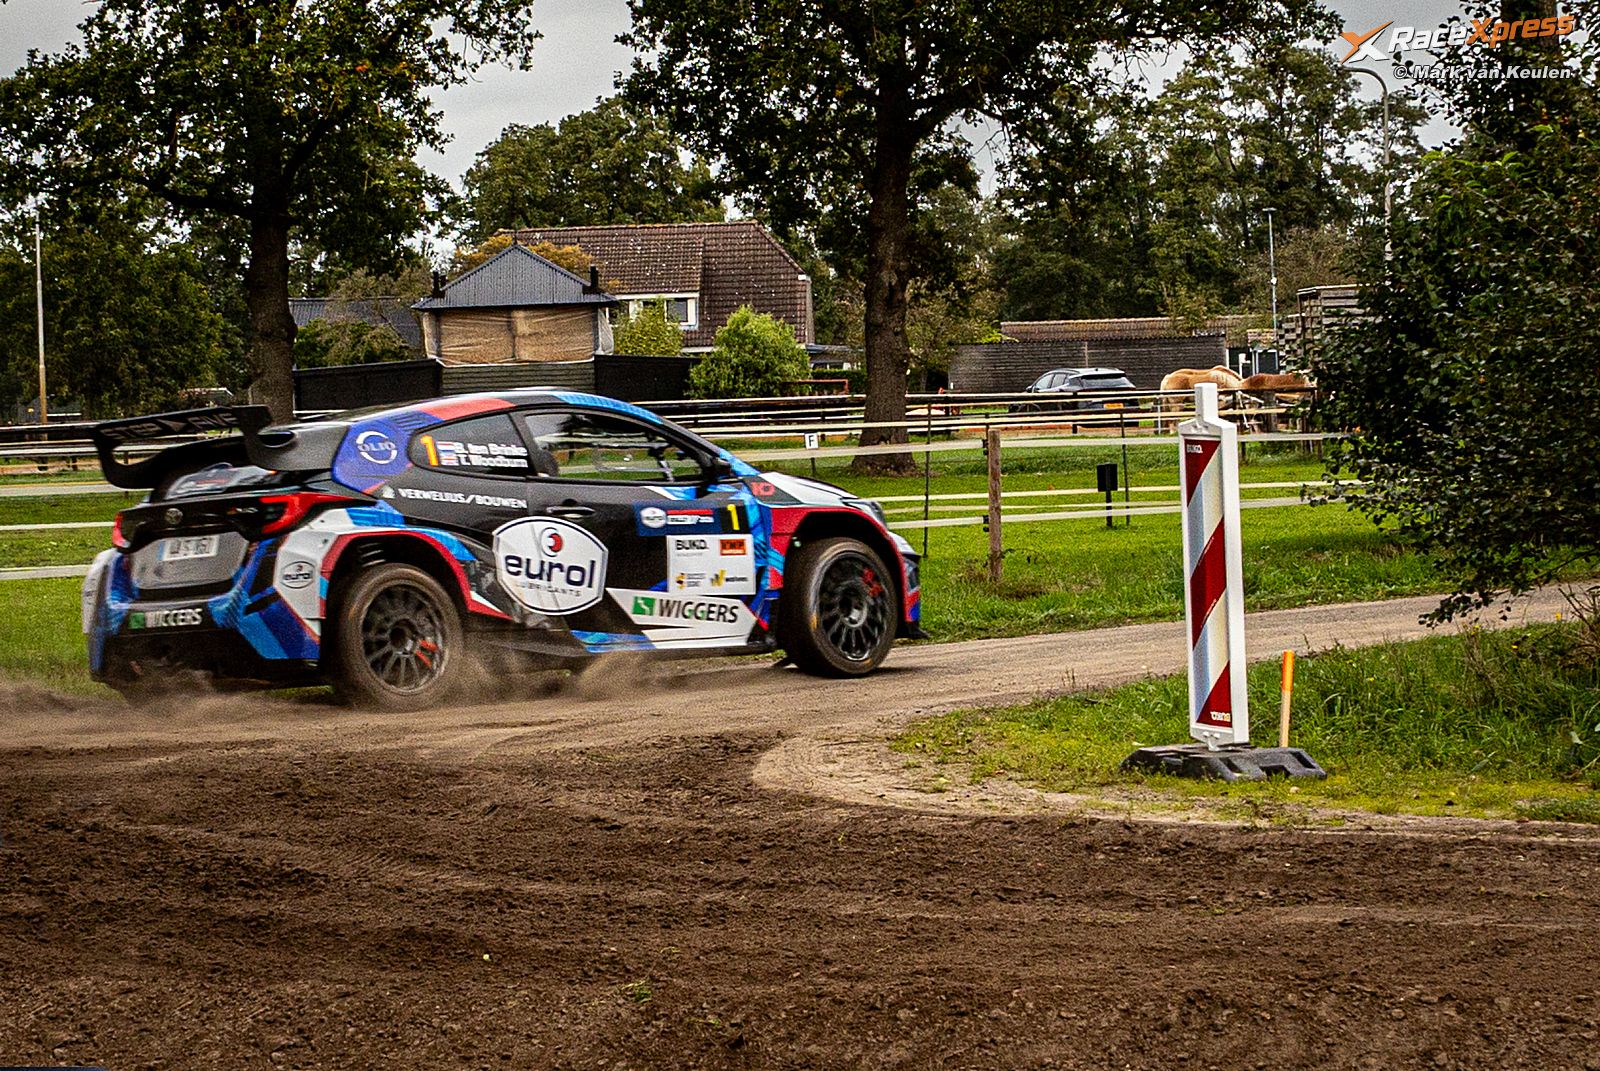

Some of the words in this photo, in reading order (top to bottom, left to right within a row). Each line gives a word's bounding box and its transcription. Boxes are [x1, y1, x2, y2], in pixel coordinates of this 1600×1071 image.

[420, 435, 439, 467] 1
[808, 435, 815, 448] F
[727, 504, 740, 531] 1
[504, 554, 596, 589] eurol
[145, 608, 203, 628] WIGGERS
[657, 598, 739, 624] WIGGERS
